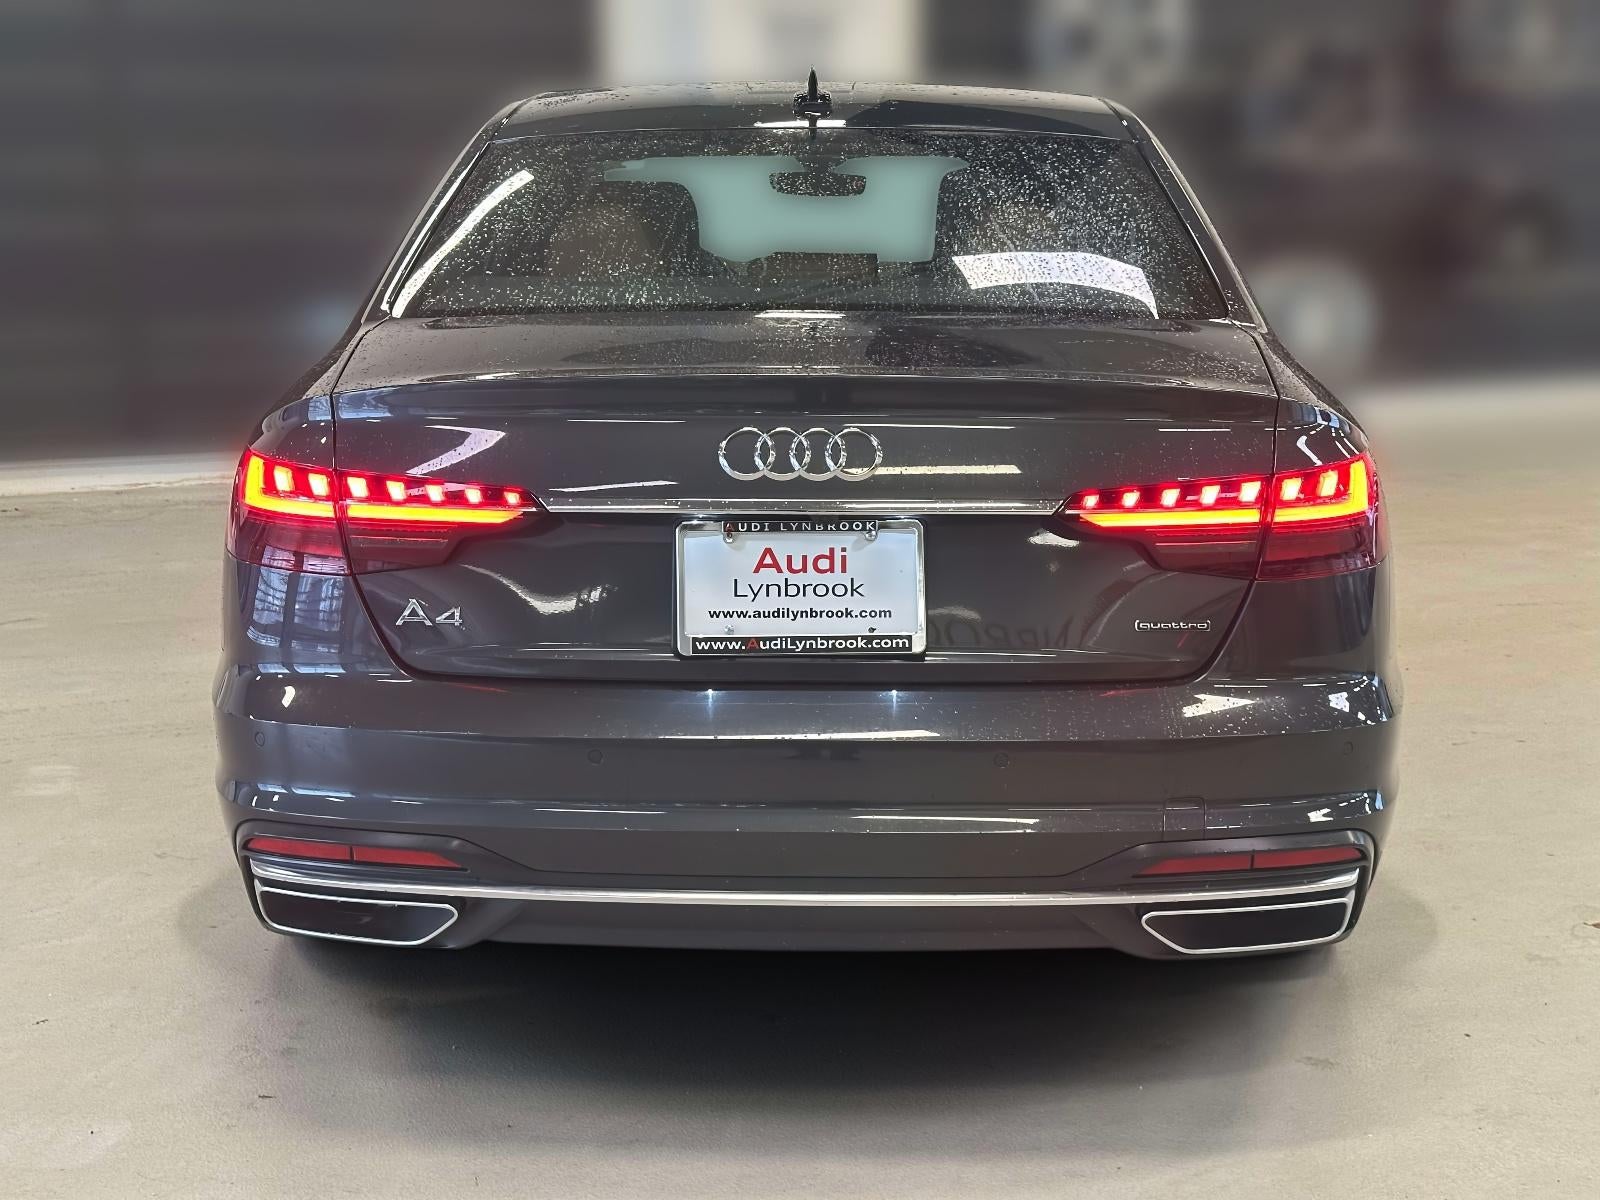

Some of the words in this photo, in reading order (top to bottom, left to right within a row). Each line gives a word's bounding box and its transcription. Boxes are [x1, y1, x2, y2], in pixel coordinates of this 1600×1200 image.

[724, 521, 771, 532] AUDI
[779, 521, 875, 532] LYNBROOK
[752, 546, 847, 575] Audi
[733, 577, 865, 603] Lynbrook
[708, 606, 892, 622] www.audilynbrook.com
[695, 636, 910, 652] www.AudiLynbrook.com
